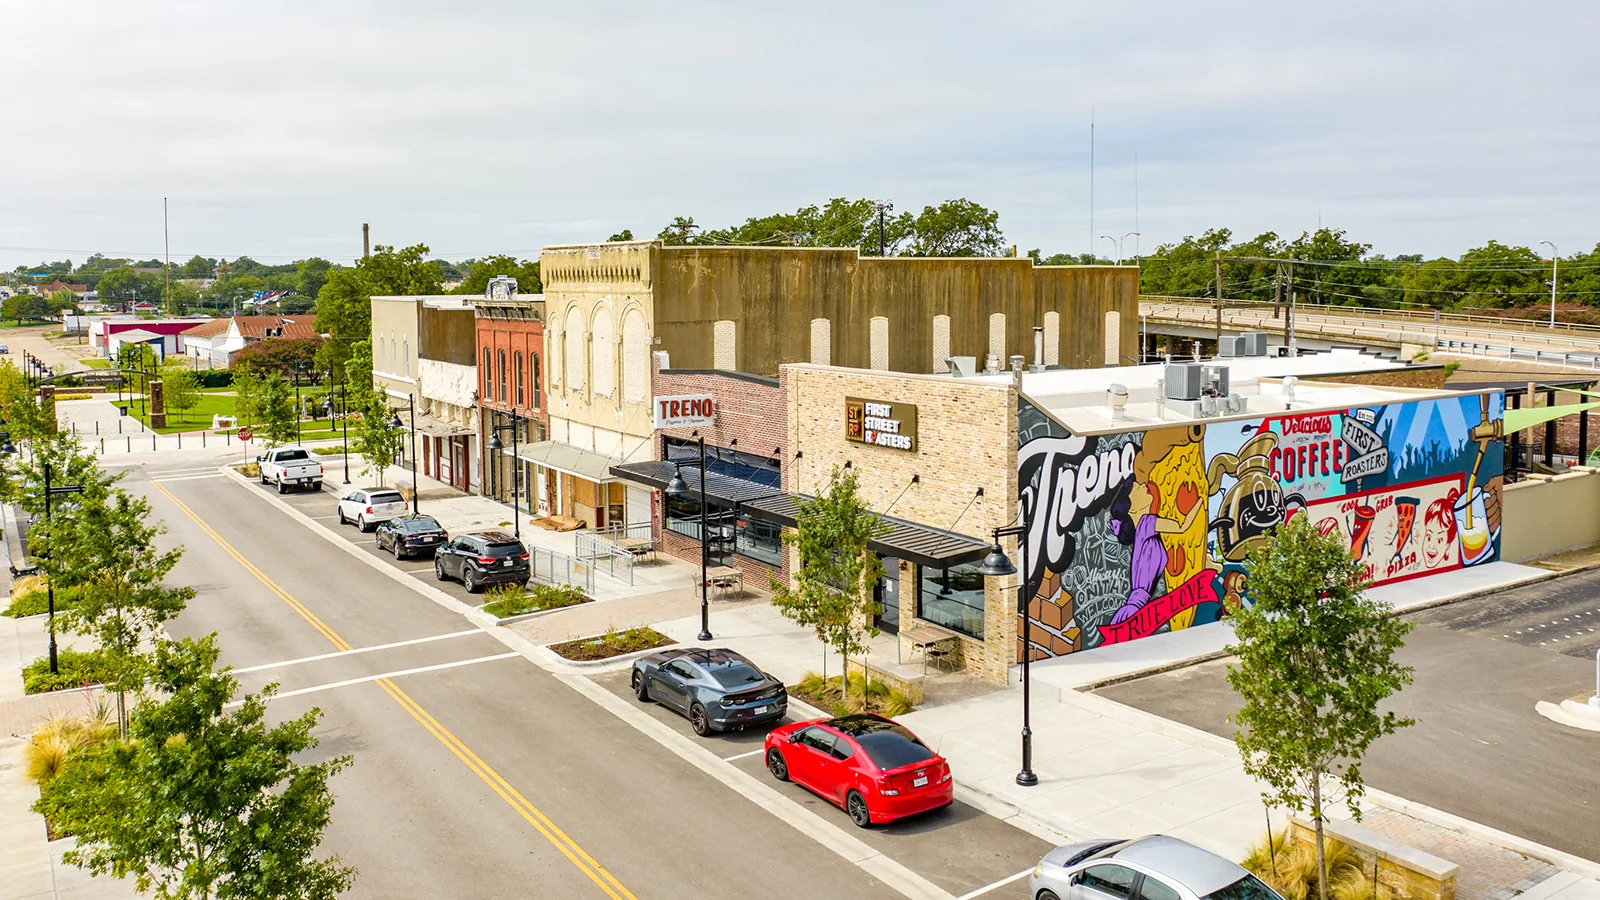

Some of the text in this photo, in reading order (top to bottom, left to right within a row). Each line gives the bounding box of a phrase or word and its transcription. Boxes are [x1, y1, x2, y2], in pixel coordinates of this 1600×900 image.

[660, 398, 713, 420] TRENO
[848, 406, 859, 419] ST
[865, 402, 892, 418] FIRST
[237, 430, 252, 438] STOP
[864, 416, 900, 433] STREET
[1280, 415, 1332, 437] Delicious
[865, 430, 912, 450] ROASTERS
[1346, 422, 1376, 453] FIRST
[1269, 439, 1342, 483] COFFEE
[1344, 452, 1387, 479] ROASTERS
[1376, 495, 1394, 513] GRAB
[1387, 551, 1417, 577] PIZZA
[1085, 567, 1127, 584] Always
[1101, 578, 1131, 597] TAP
[1109, 574, 1209, 643] TRUE LOVE
